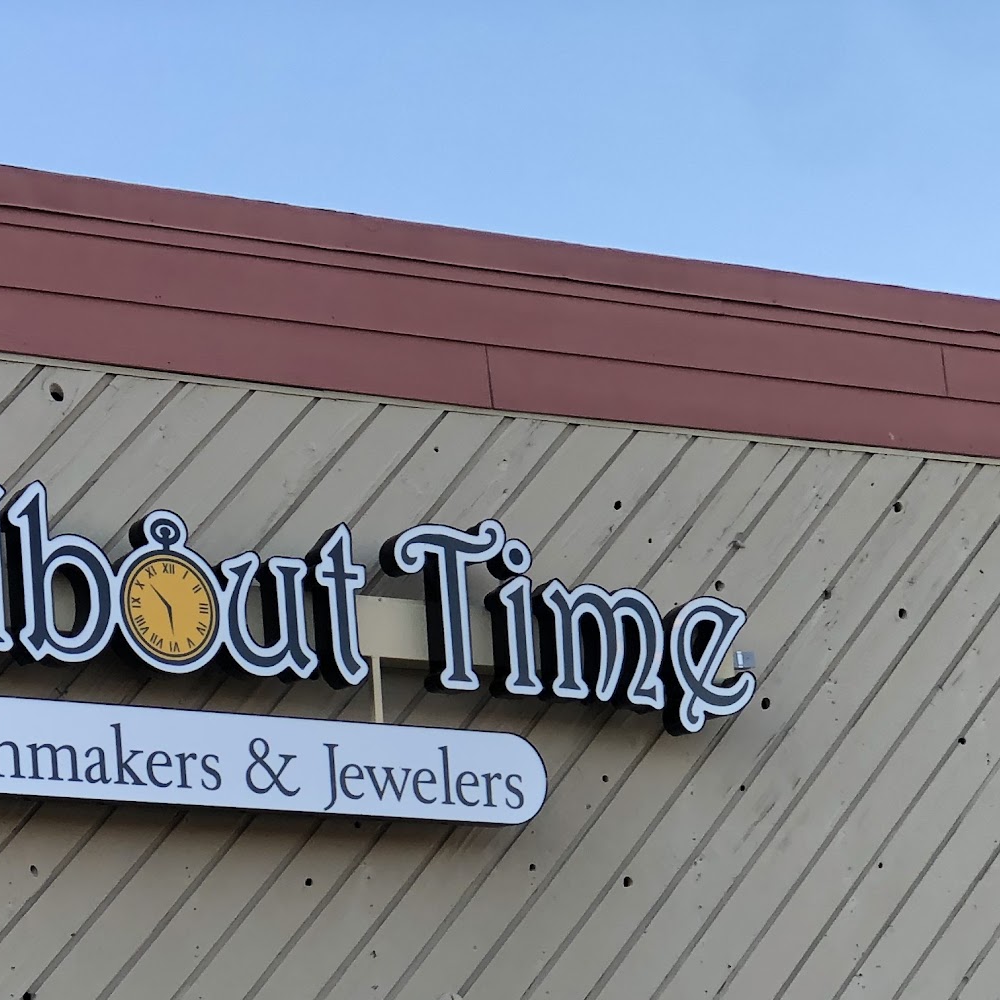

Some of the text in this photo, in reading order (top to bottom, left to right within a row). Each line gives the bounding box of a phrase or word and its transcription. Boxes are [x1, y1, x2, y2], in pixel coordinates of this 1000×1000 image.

[393, 517, 757, 734] Time
[244, 736, 301, 798] &
[323, 742, 525, 811] Jewelers
